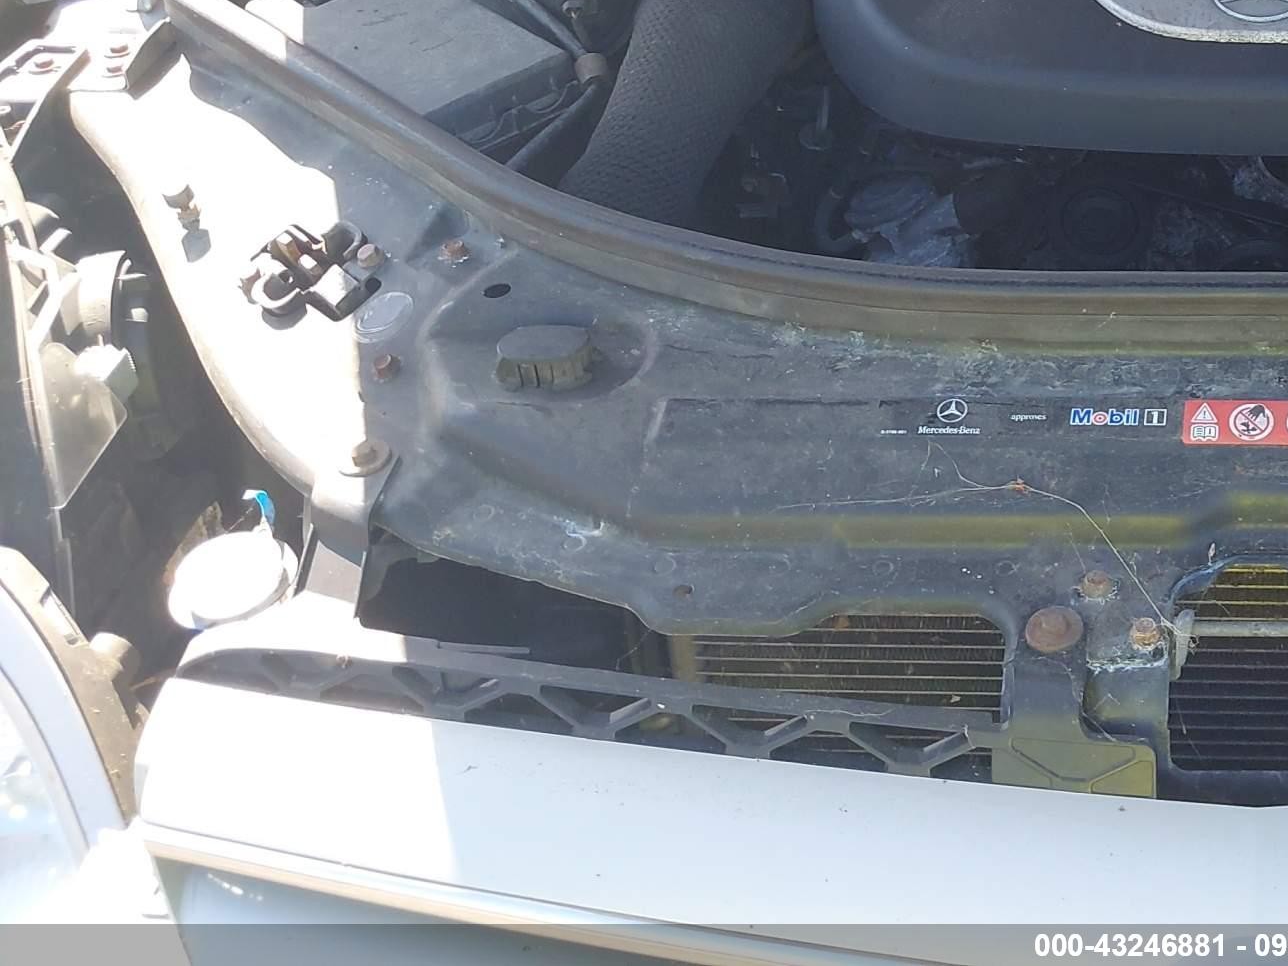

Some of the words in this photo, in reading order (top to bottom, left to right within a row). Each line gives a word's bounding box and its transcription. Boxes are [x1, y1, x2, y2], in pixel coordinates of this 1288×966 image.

[1010, 413, 1047, 421] approves
[1069, 408, 1140, 426] Mobil
[917, 425, 981, 434] Mercedes-Benz
